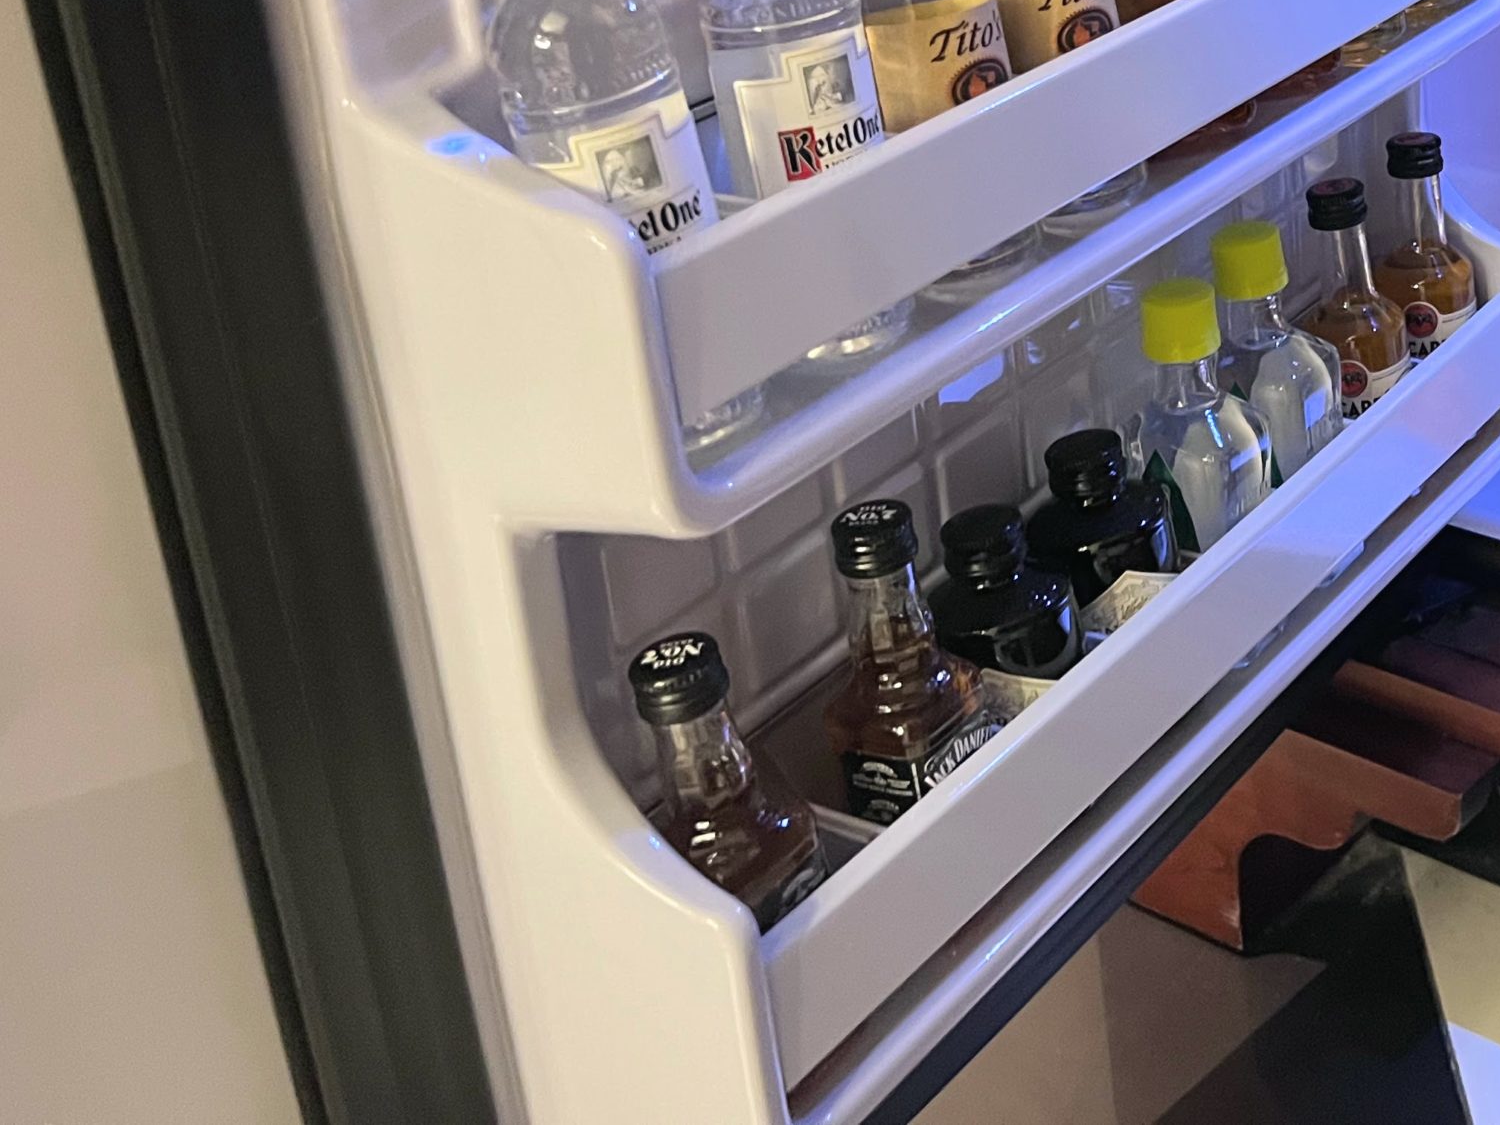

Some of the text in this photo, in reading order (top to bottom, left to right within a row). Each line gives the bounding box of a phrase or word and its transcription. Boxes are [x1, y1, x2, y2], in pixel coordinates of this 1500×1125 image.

[781, 113, 880, 174] Ketel One
[660, 194, 702, 233] One
